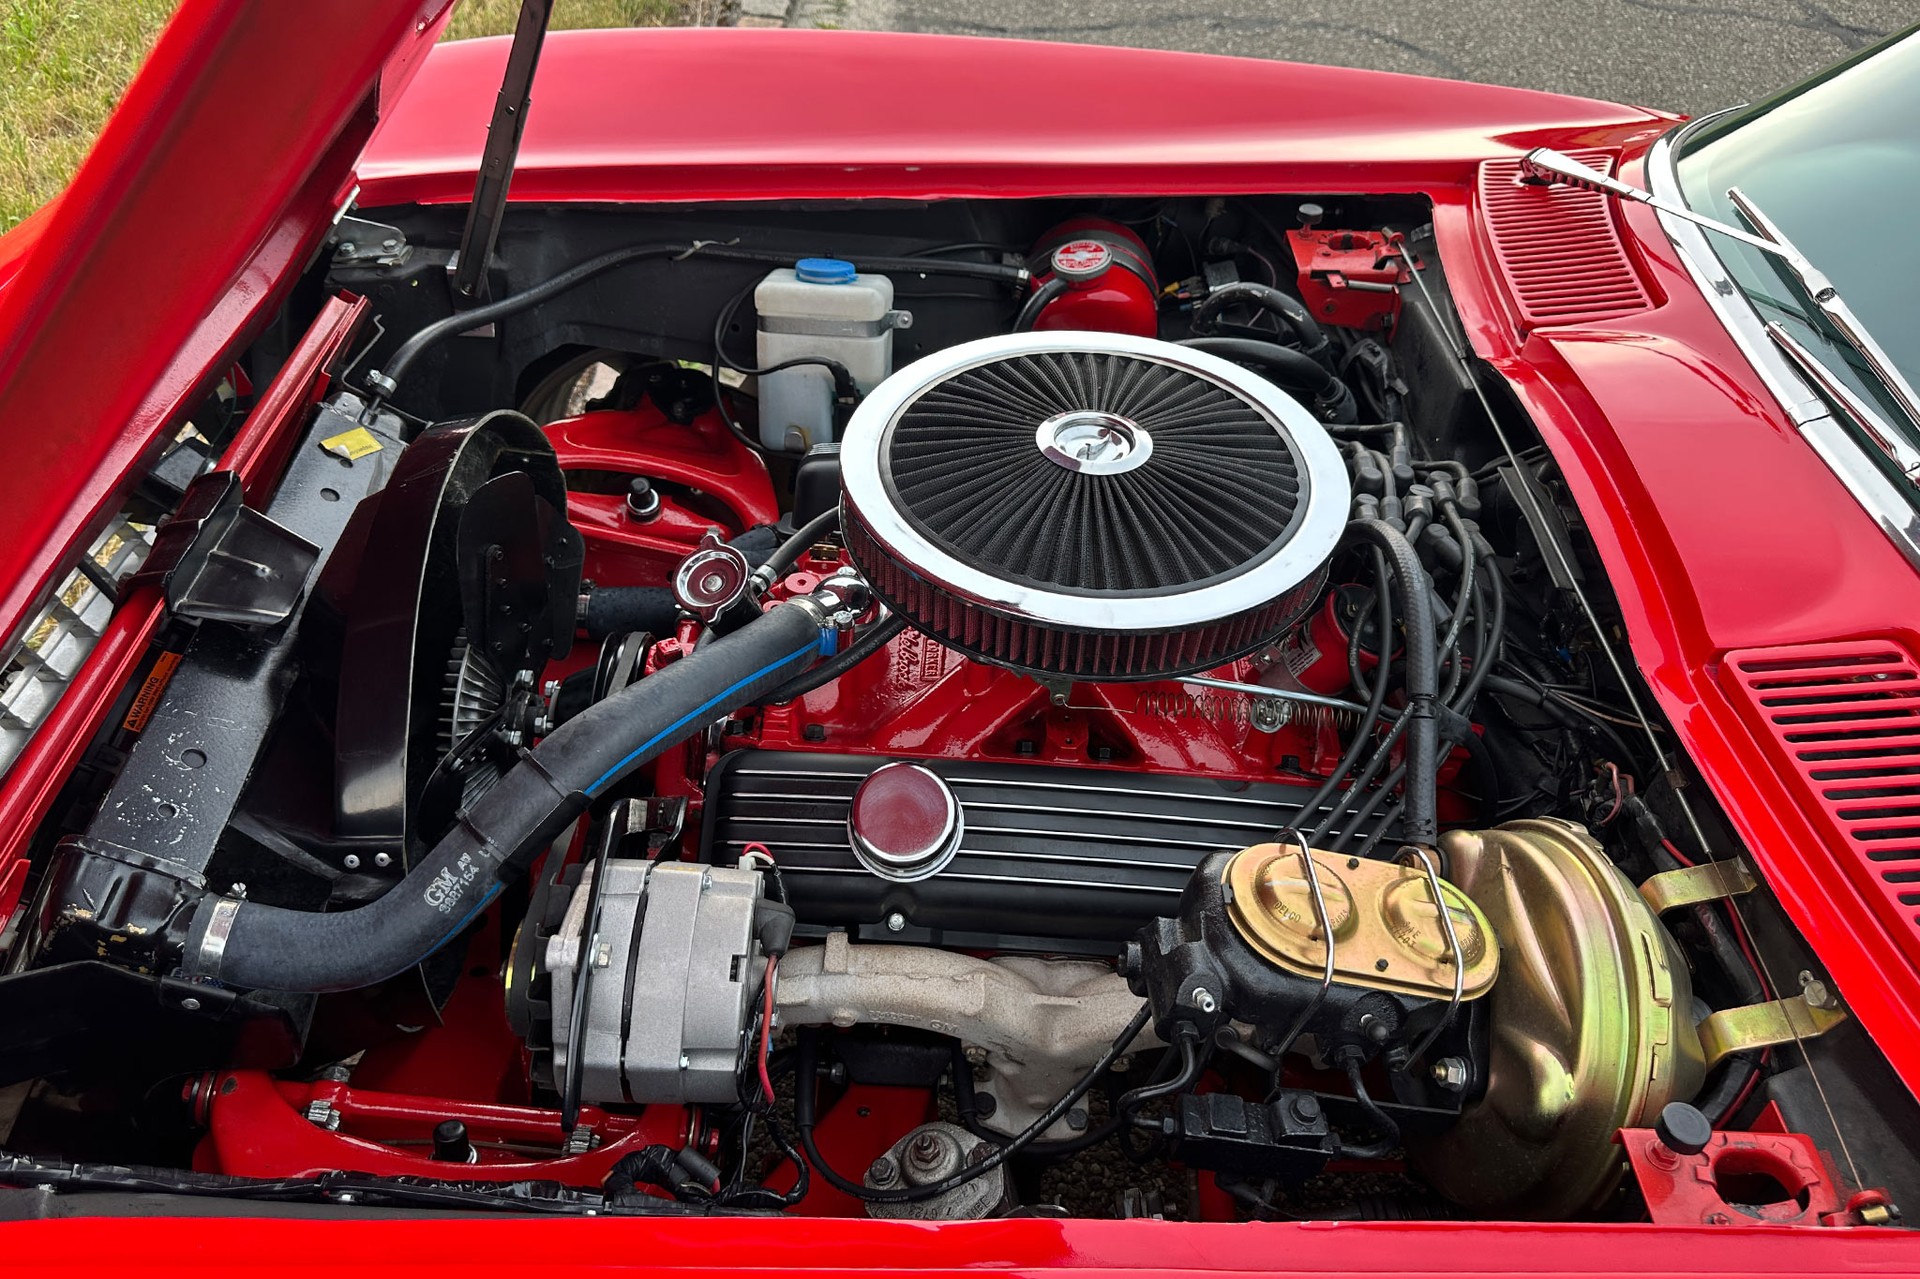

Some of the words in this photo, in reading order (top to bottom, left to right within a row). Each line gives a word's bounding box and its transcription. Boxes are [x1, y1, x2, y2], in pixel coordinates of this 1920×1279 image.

[132, 677, 159, 717] WARNING
[424, 866, 459, 907] GM
[1274, 901, 1301, 923] DELCO
